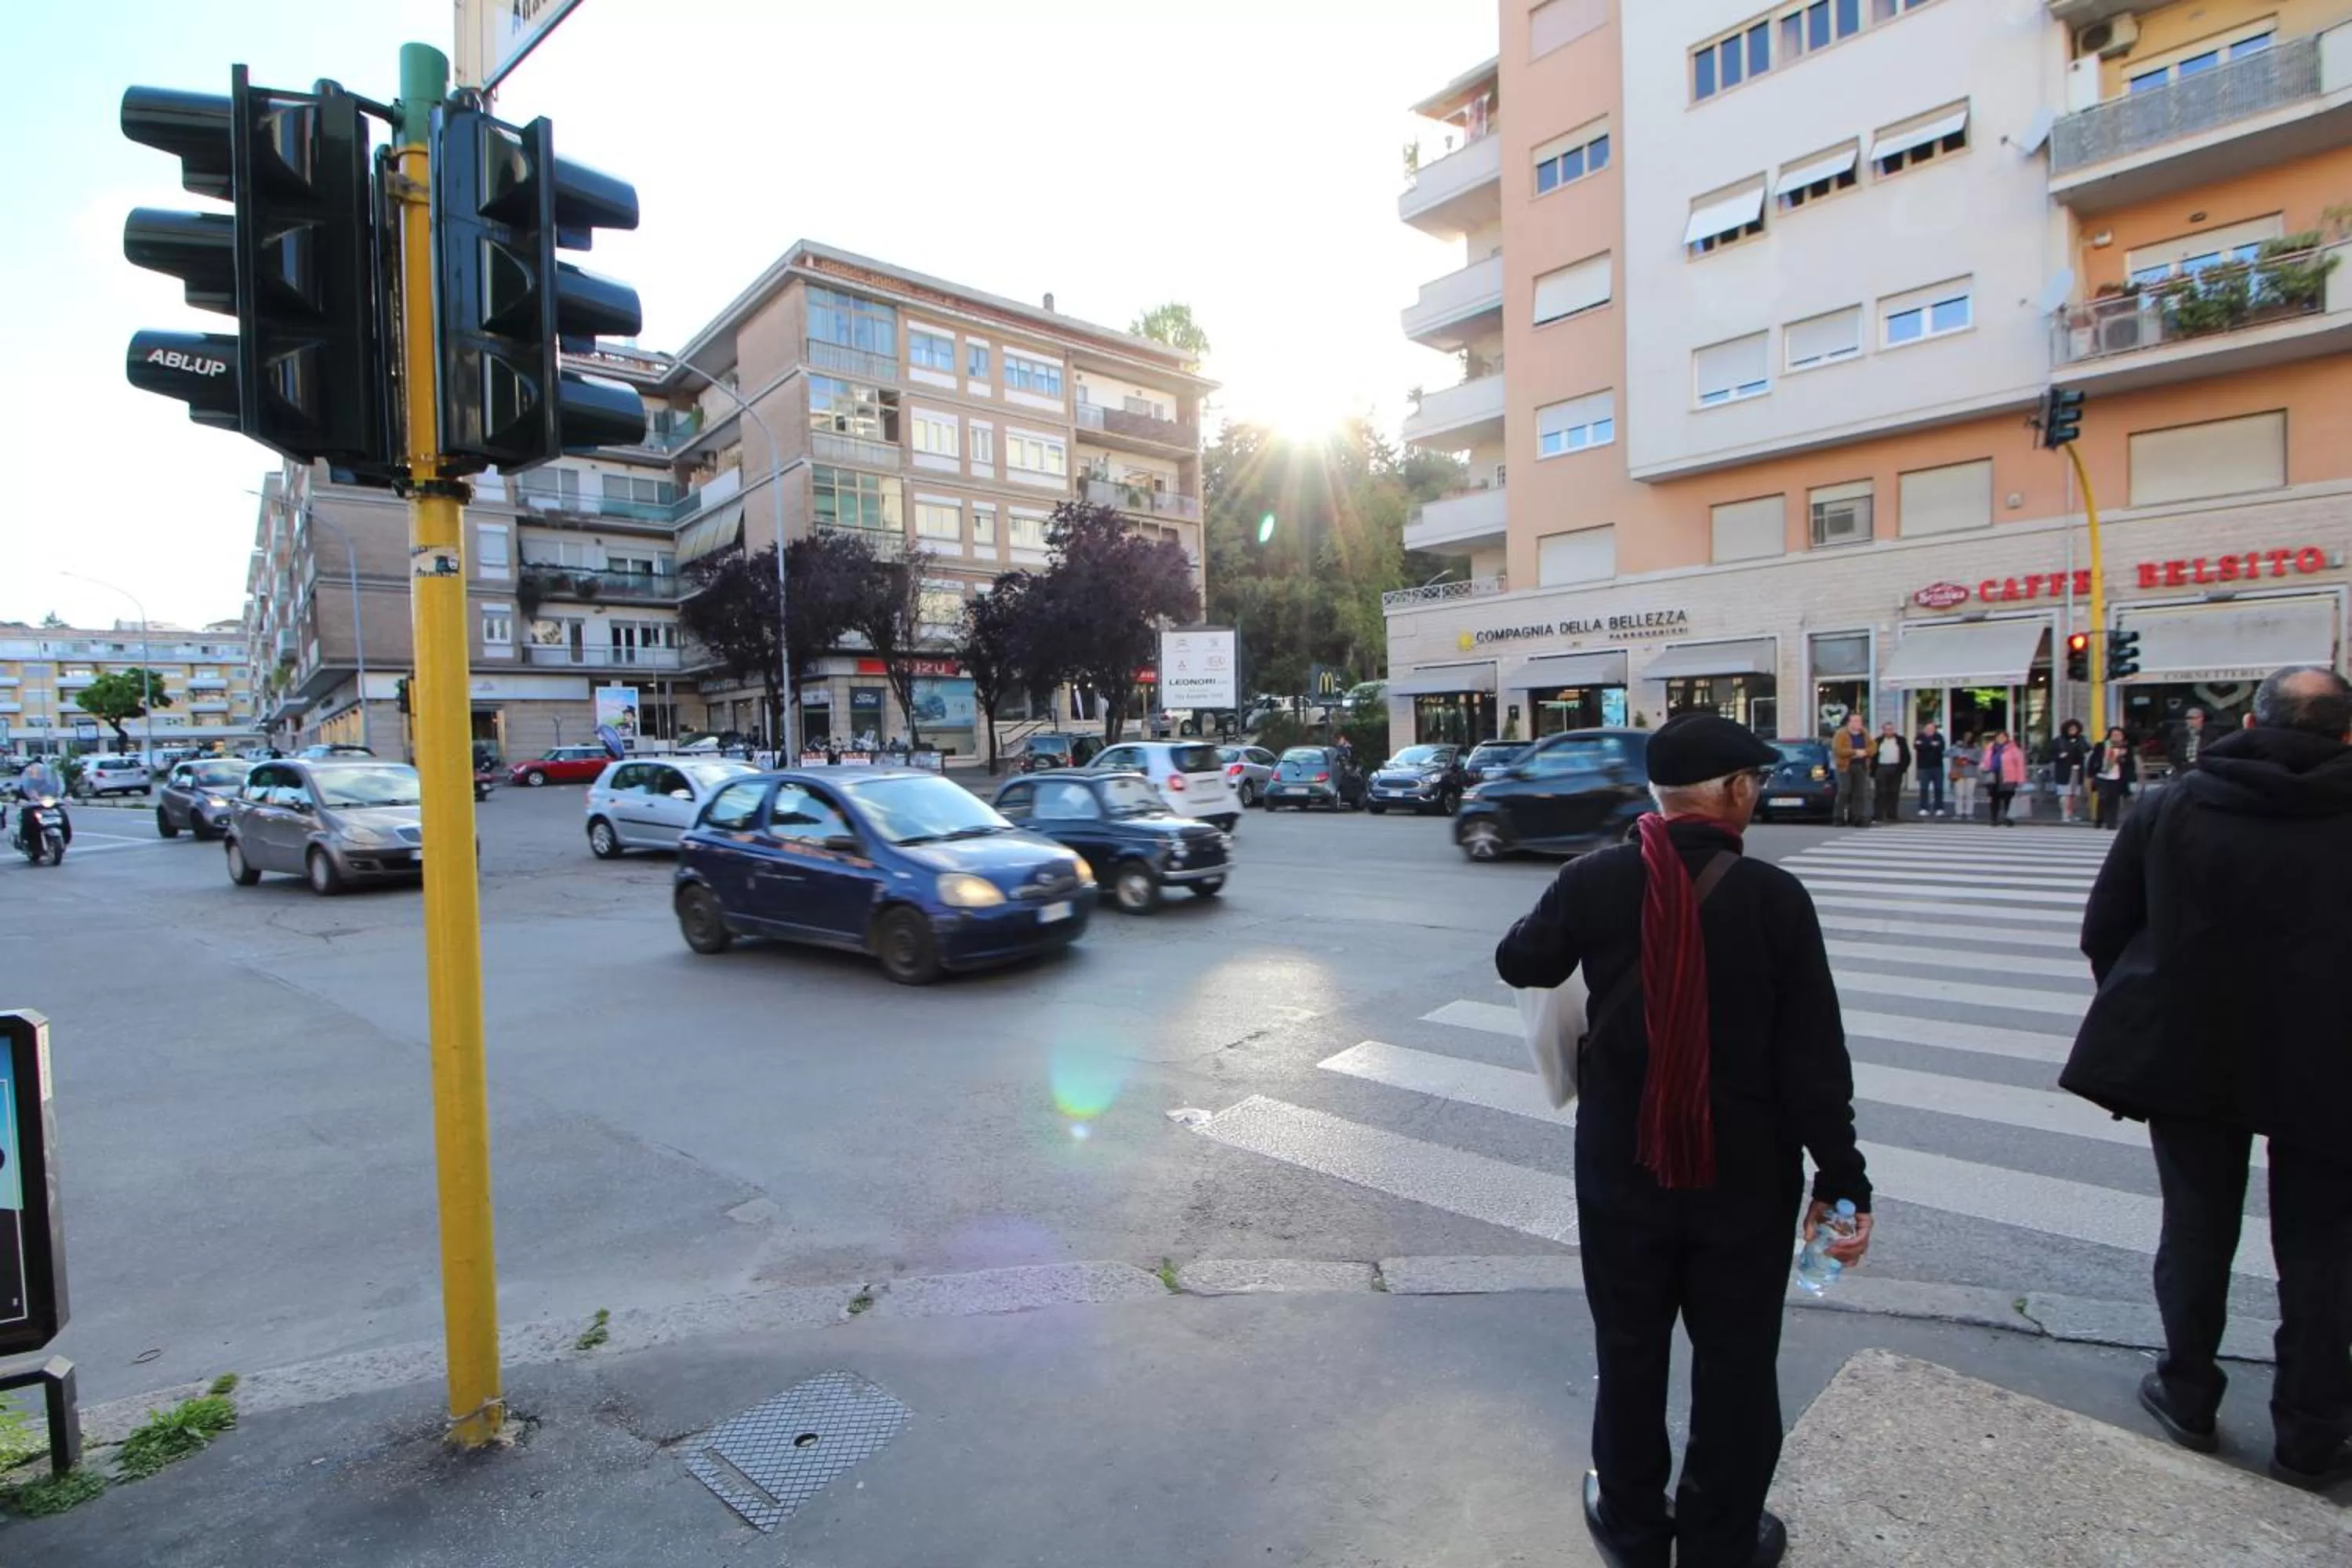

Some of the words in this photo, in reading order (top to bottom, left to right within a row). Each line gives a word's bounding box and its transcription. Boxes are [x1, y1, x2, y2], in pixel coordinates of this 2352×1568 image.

[147, 348, 227, 377] ABLUP
[2136, 545, 2326, 589] BELSITO
[1476, 624, 1555, 643] COMPAGNIA
[1559, 619, 1602, 635] DELLA
[1609, 609, 1687, 630] BELLEZZA
[1169, 677, 1216, 687] LEONORI
